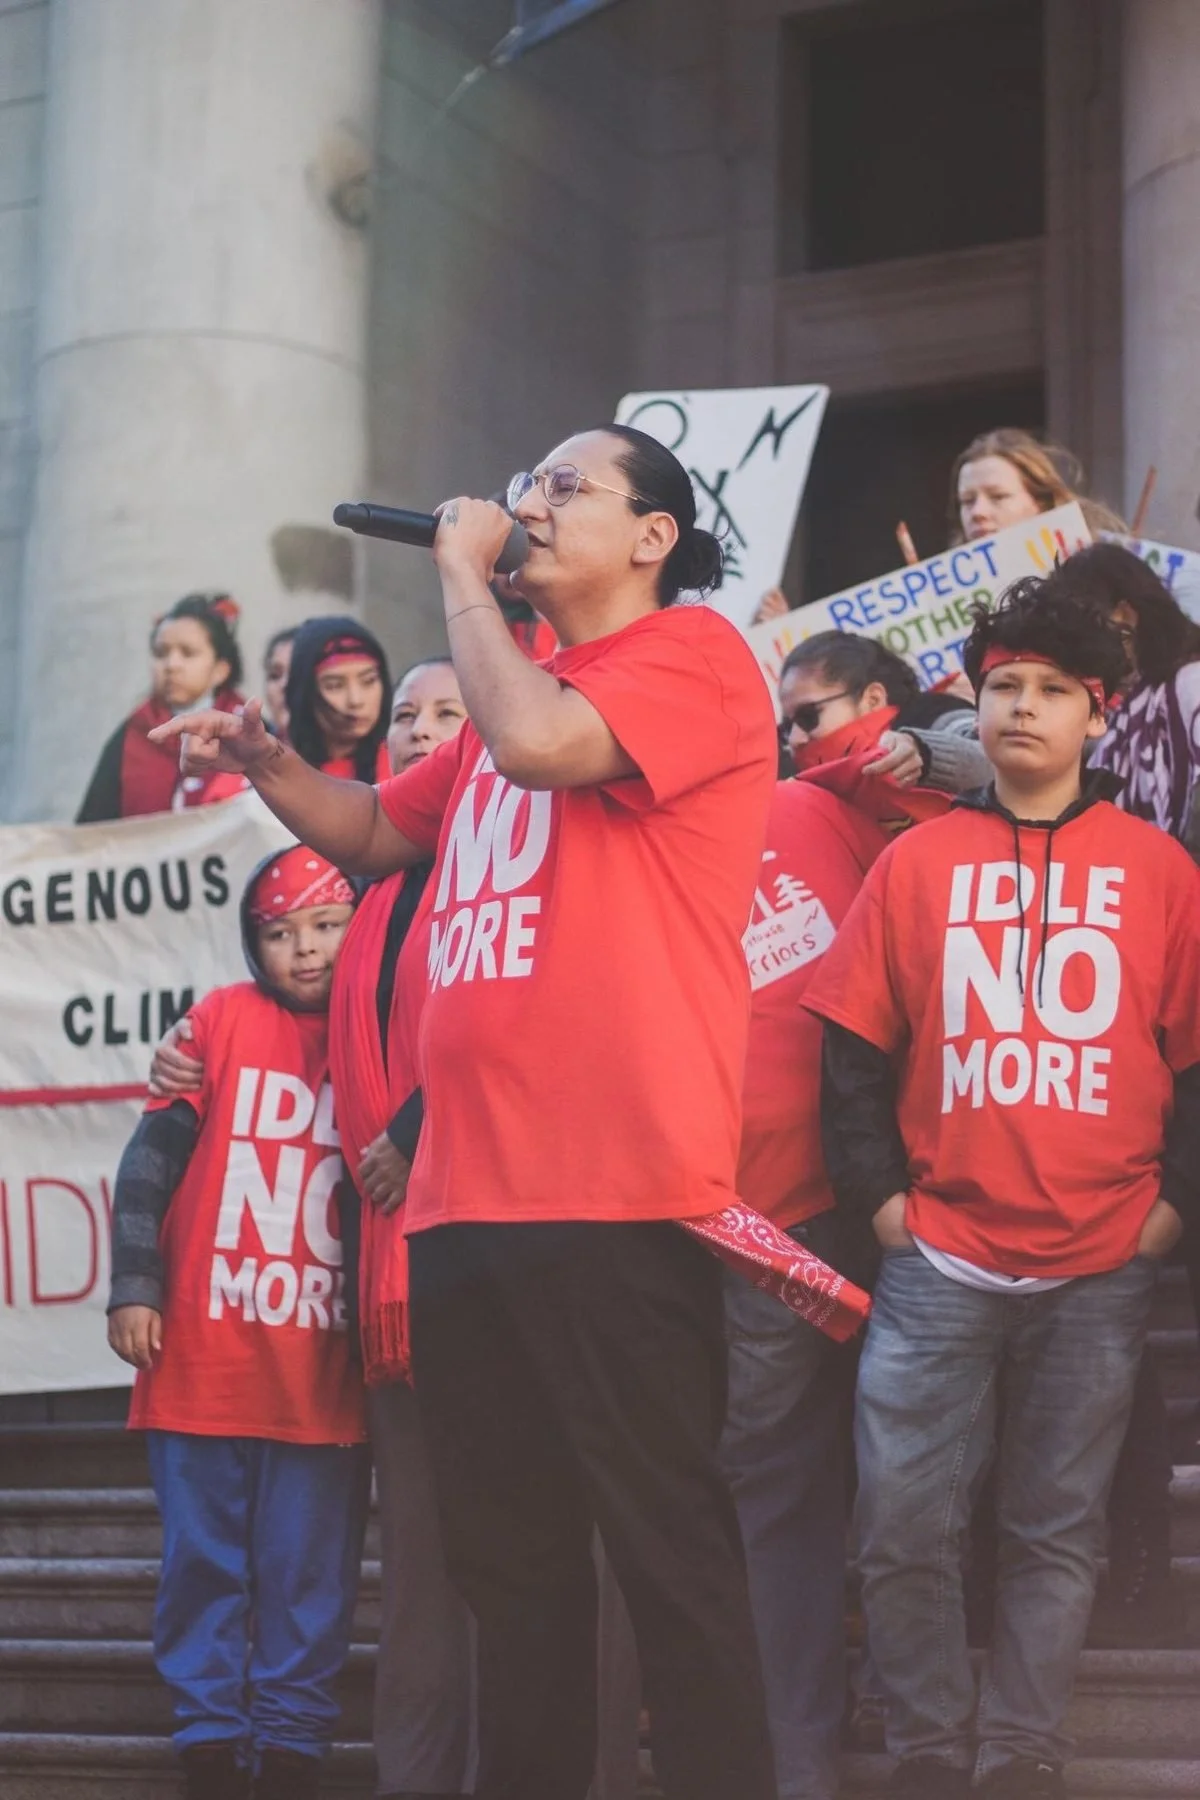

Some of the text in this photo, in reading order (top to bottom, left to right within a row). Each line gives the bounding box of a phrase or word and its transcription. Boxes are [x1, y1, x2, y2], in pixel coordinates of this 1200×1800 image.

[828, 540, 998, 631] RESPECT
[875, 588, 994, 655] OTHER
[434, 775, 552, 912] NO
[948, 861, 1124, 929] IDLE
[427, 896, 541, 994] MORE
[942, 926, 1121, 1041] NO
[941, 1037, 1111, 1116] MORE
